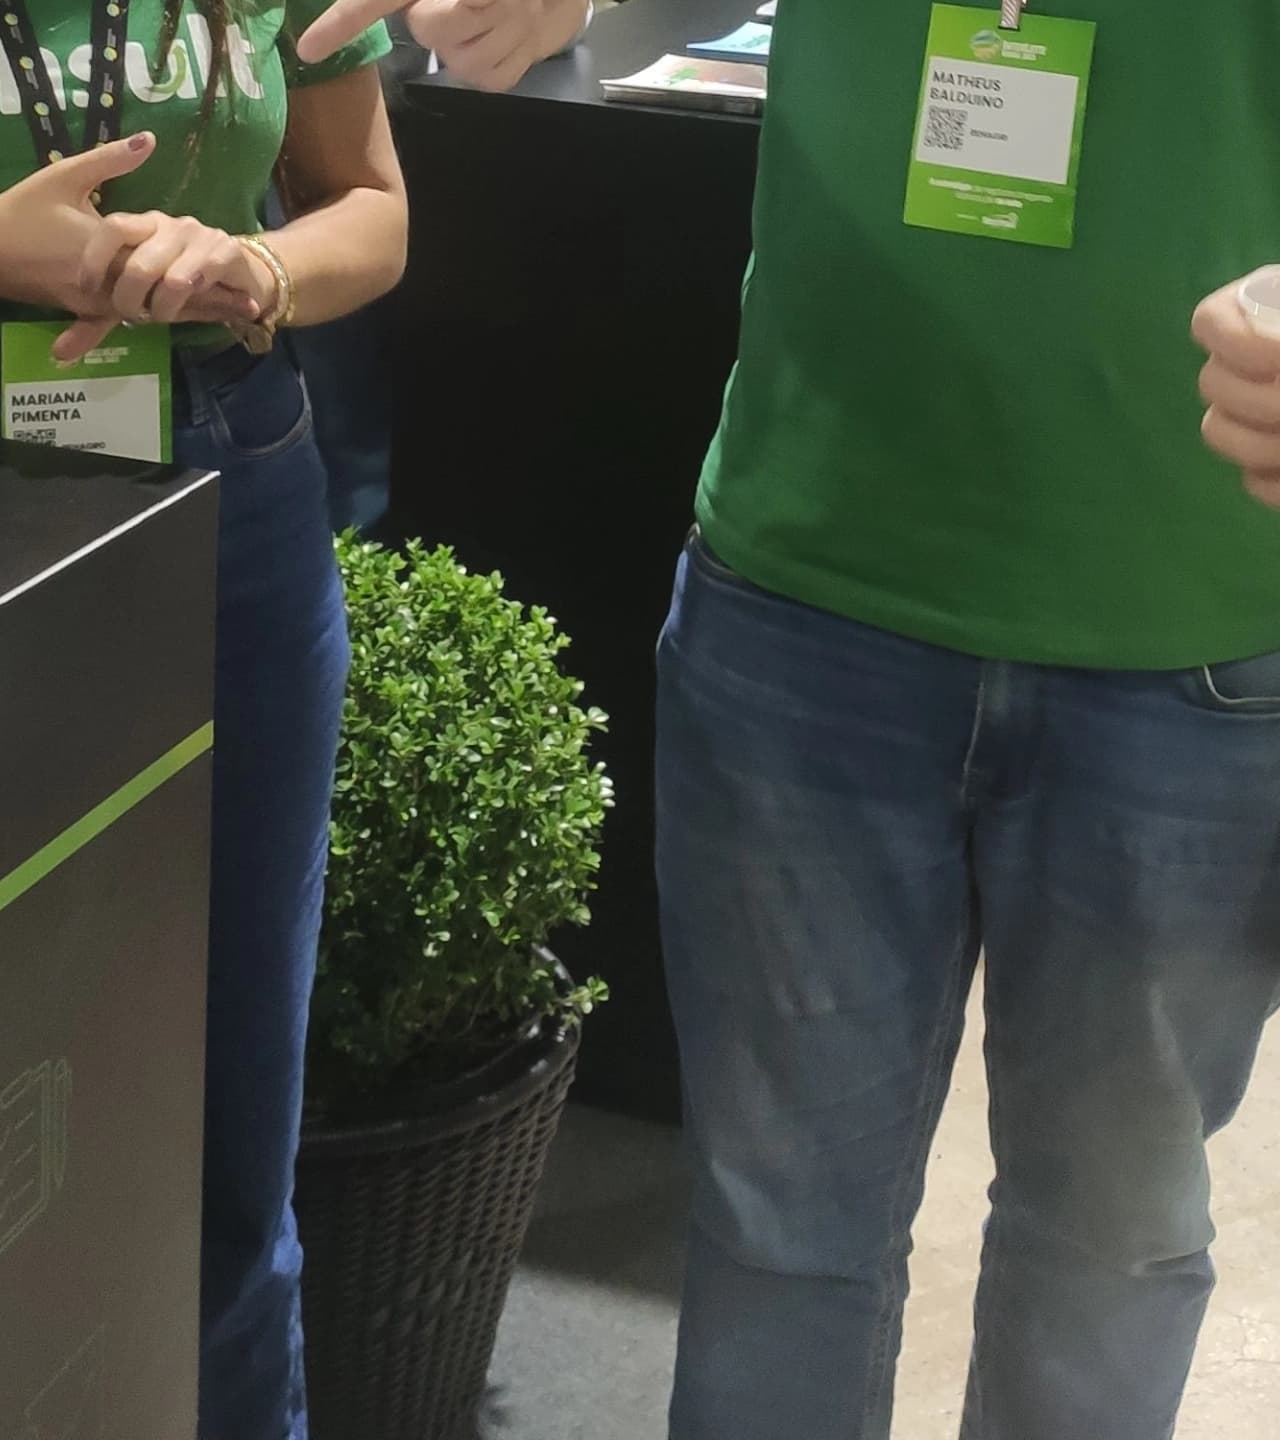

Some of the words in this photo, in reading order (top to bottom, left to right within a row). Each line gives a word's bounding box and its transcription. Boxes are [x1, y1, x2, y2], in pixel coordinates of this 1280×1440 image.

[933, 69, 1002, 92] MATHEUS
[930, 86, 1005, 110] BALDUINO
[11, 391, 87, 407] MARIANA
[11, 408, 82, 424] PIMENTA
